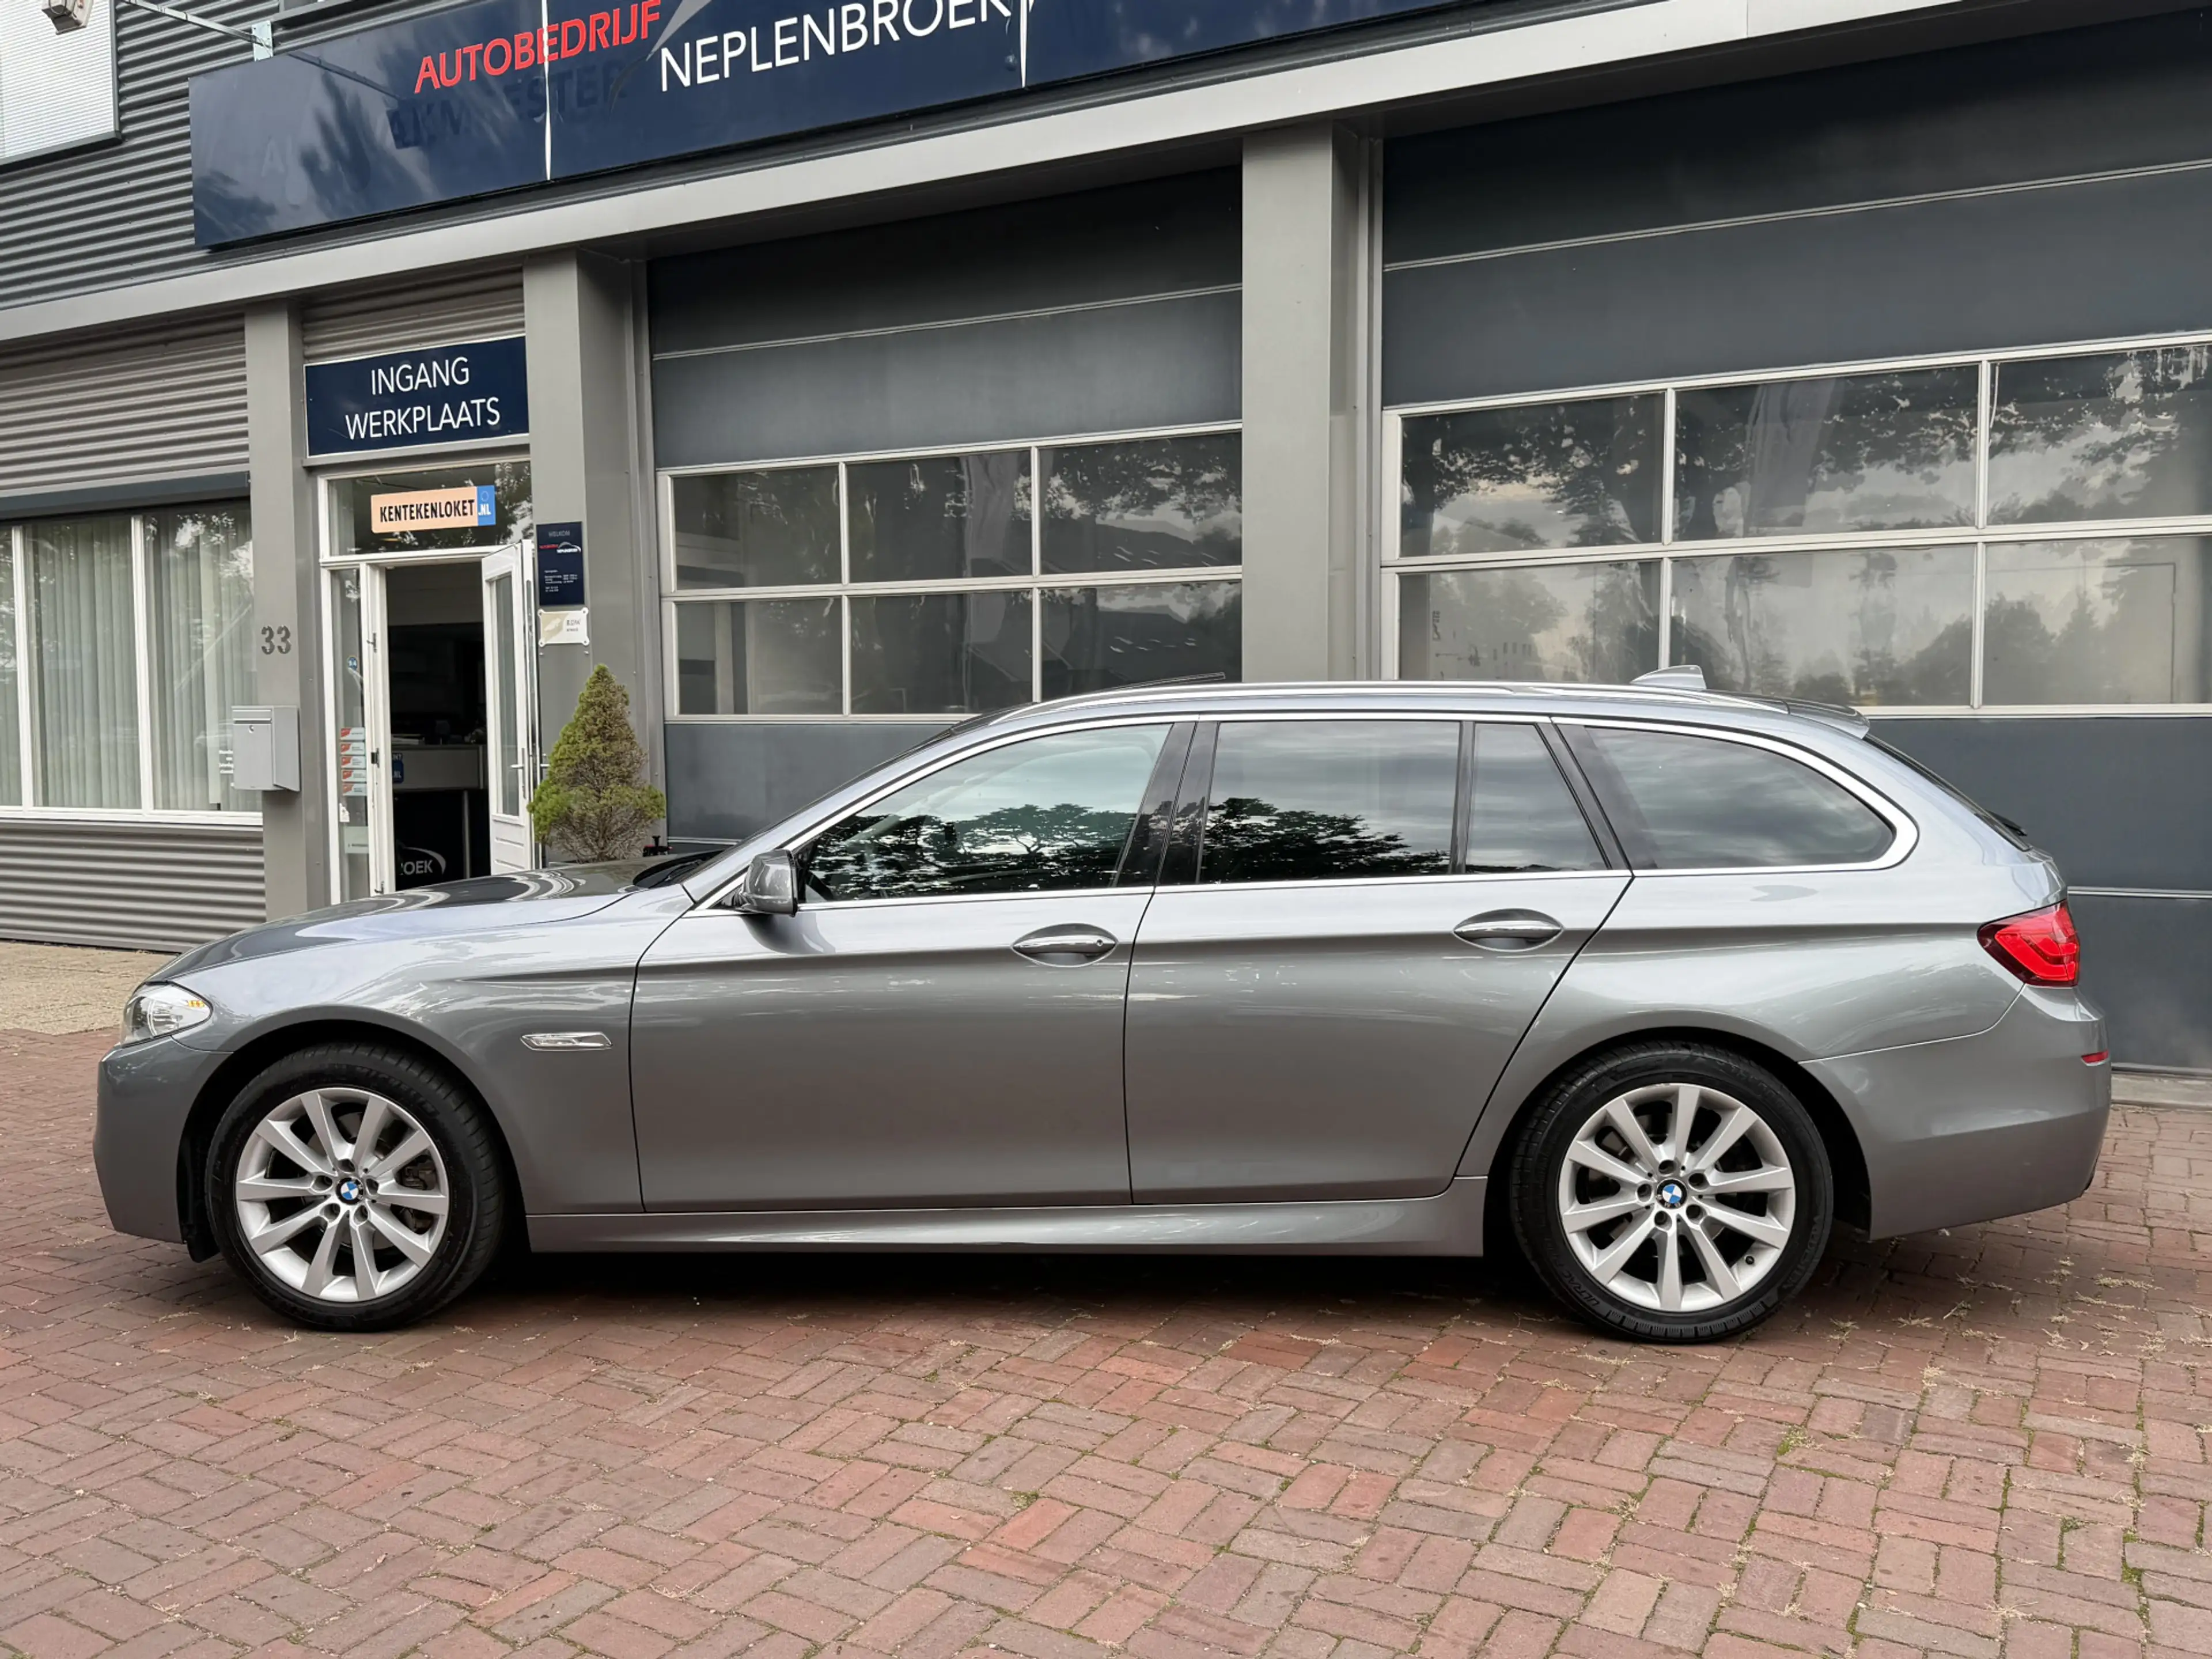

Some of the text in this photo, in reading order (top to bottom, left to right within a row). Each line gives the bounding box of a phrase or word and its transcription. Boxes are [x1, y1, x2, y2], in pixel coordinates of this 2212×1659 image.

[414, 0, 661, 94] AUTOBEDRIJF
[371, 357, 470, 395] INGANG
[346, 396, 501, 440] WERKPLAATS
[380, 499, 475, 523] KENTEKENLOKET
[261, 626, 291, 655] 33
[400, 859, 433, 876] OEK
